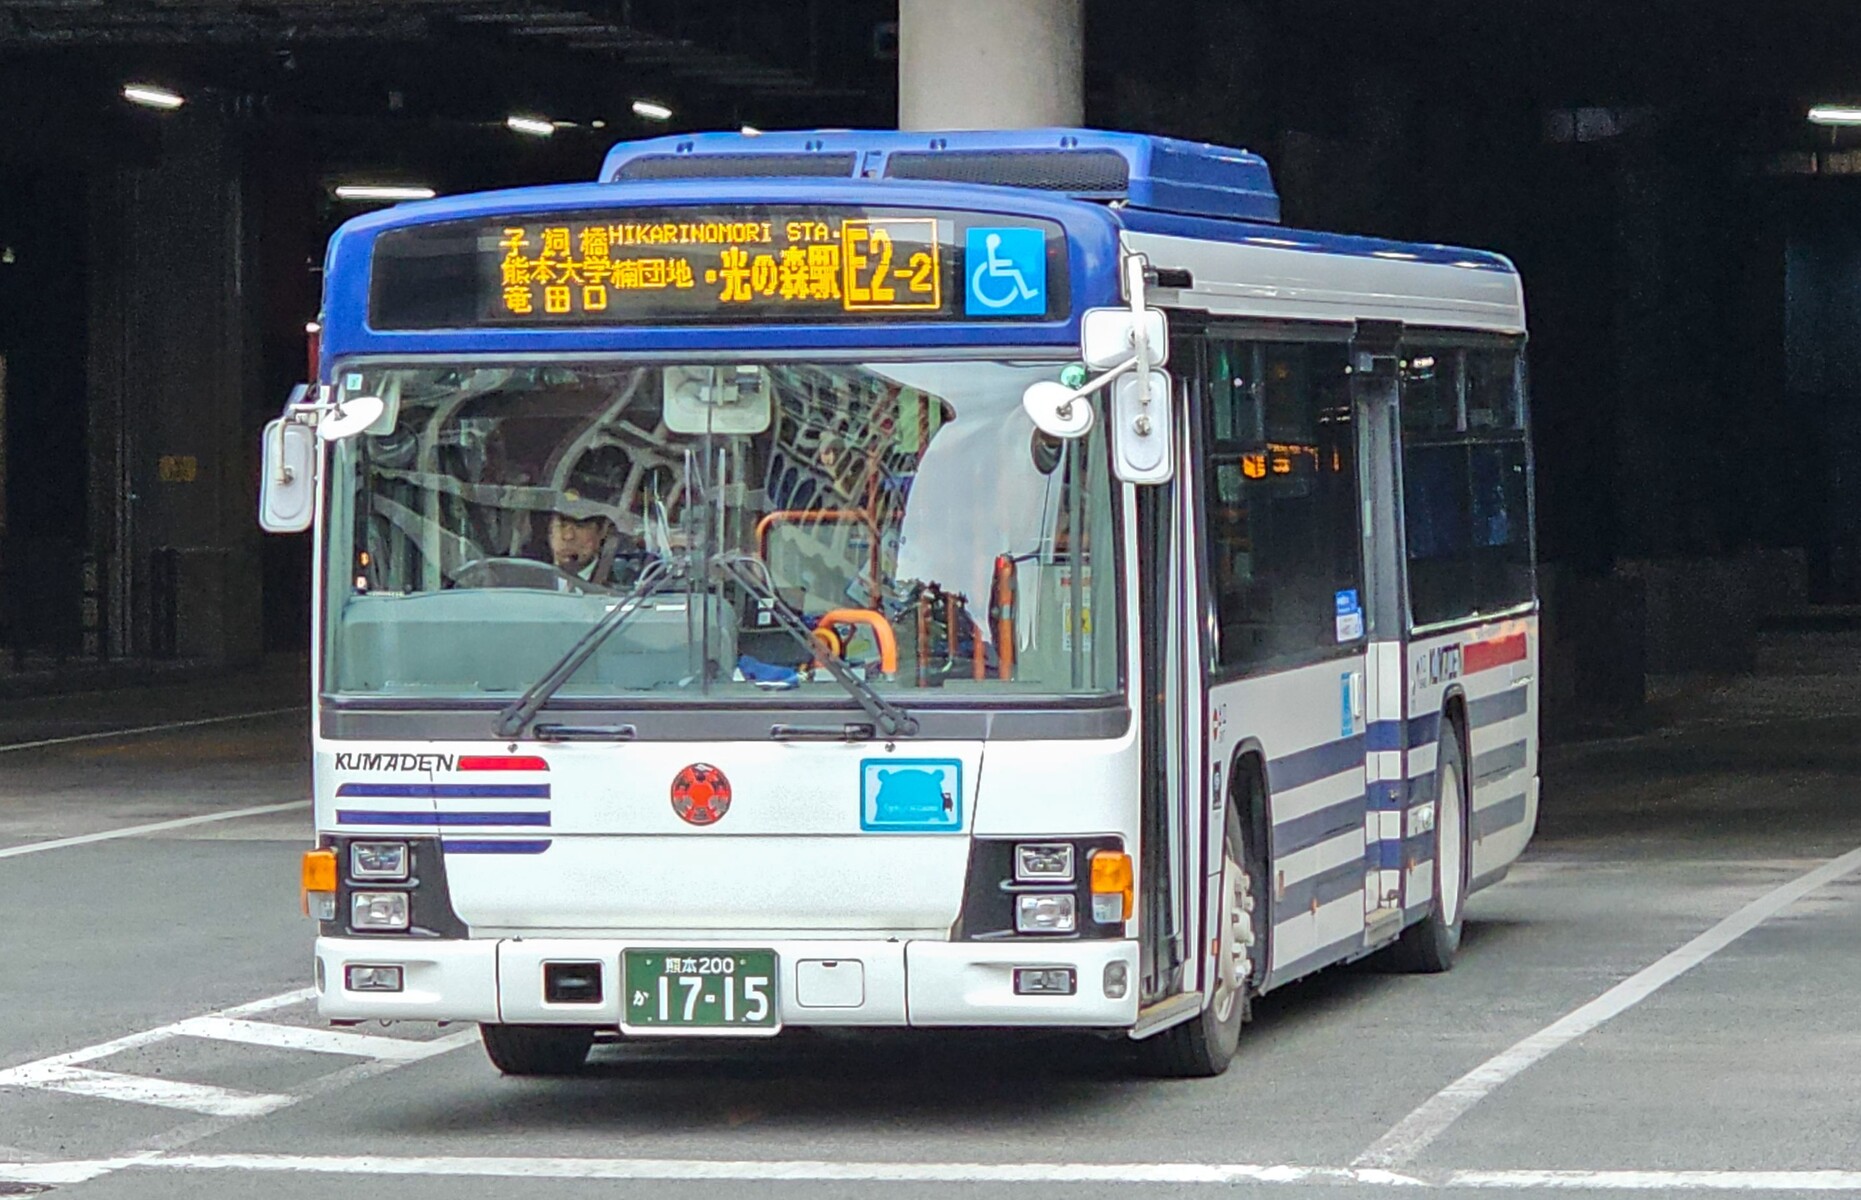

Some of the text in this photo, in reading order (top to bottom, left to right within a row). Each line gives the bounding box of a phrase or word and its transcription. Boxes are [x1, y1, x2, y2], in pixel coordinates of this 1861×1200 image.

[608, 223, 772, 244] HIKARINOMORI
[501, 256, 612, 285] 熊本大学
[503, 285, 607, 313] 竜田口
[335, 753, 453, 772] KUMADEN
[659, 976, 769, 1021] 17-15
